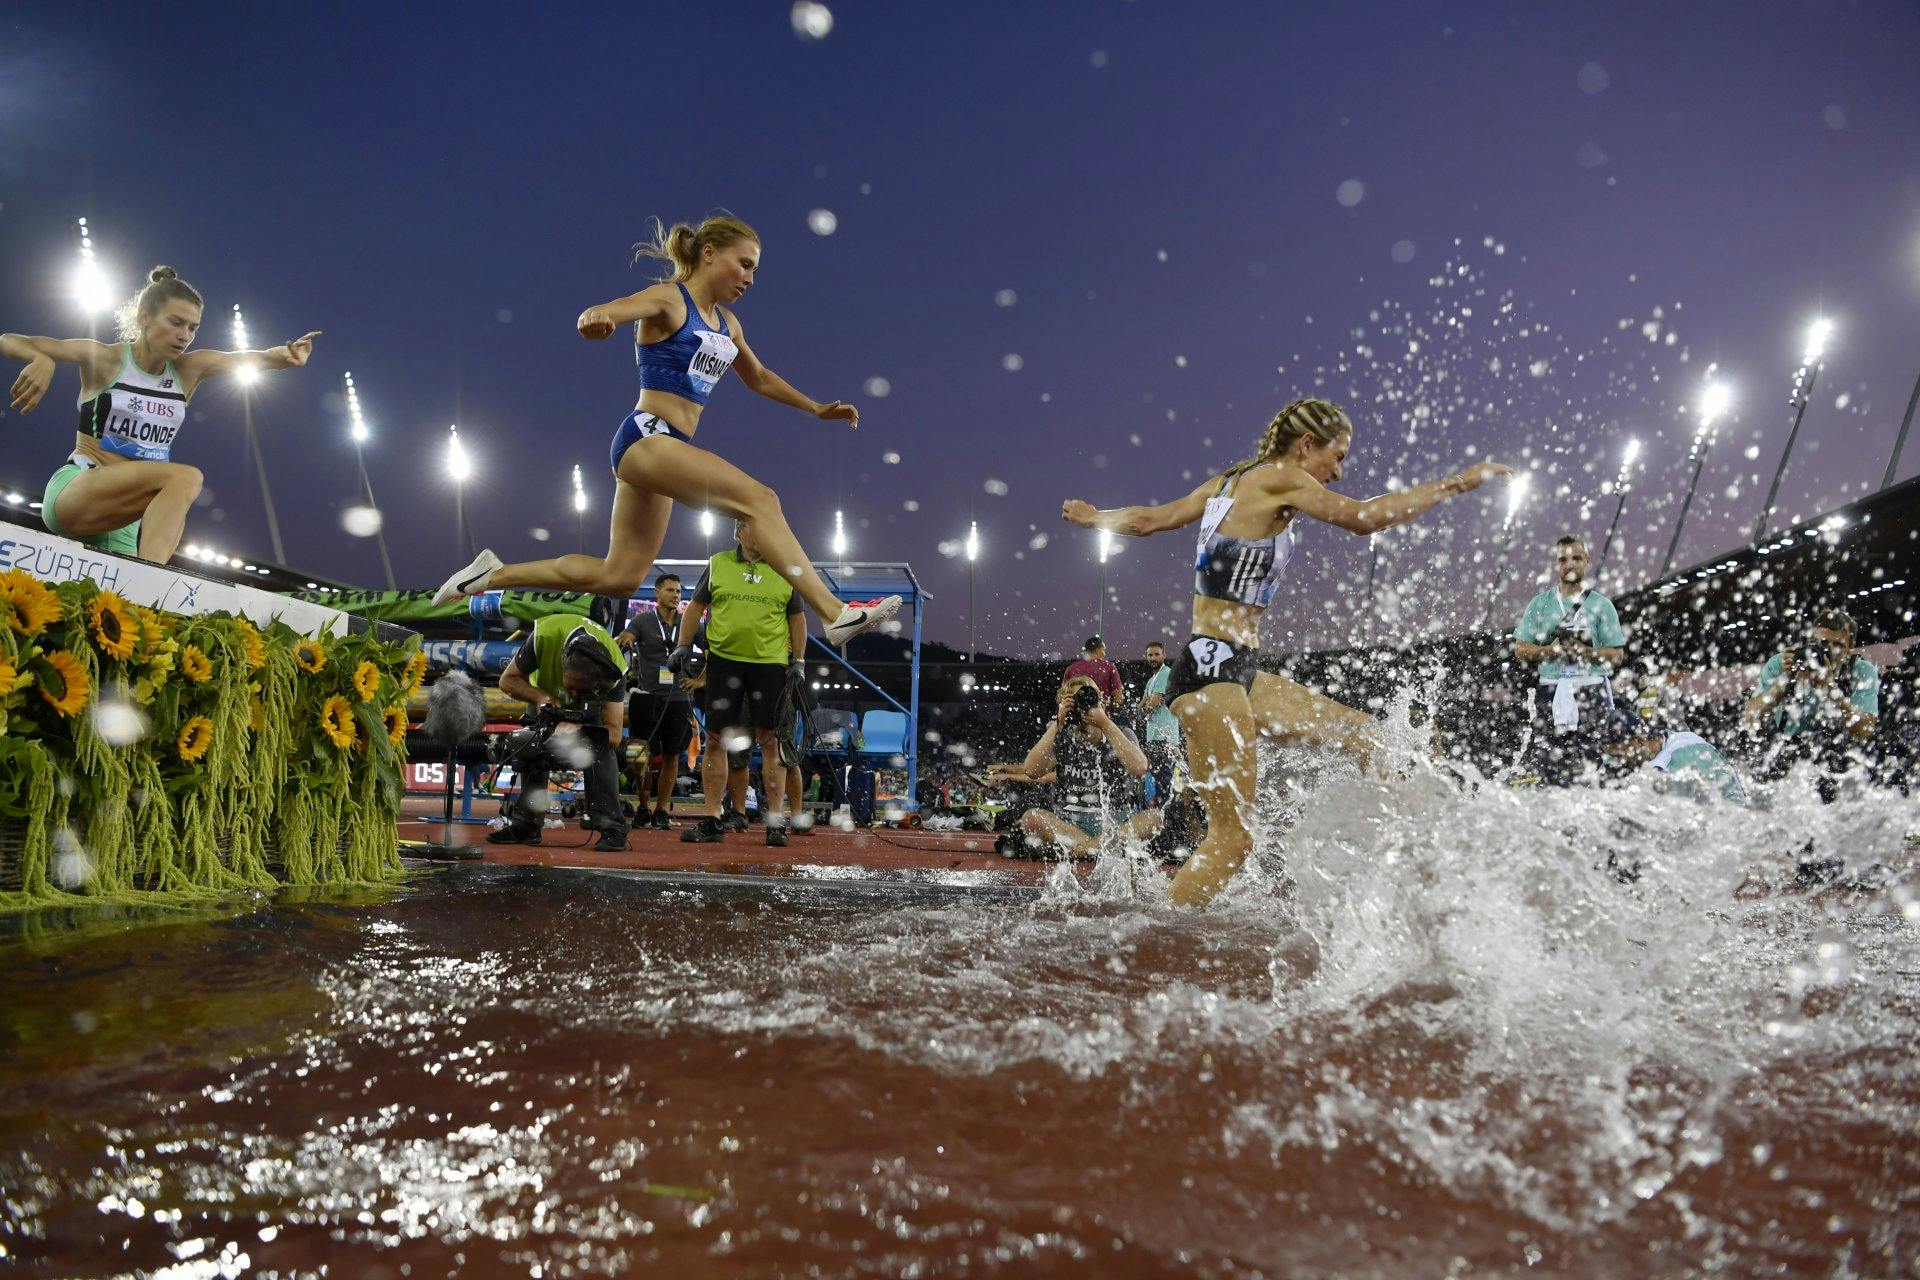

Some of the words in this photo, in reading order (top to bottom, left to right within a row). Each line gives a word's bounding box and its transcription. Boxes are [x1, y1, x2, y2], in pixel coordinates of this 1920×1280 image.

[146, 401, 175, 418] UBS
[108, 415, 175, 444] LALONDE
[643, 416, 660, 434] 4
[1200, 640, 1218, 666] 3
[1063, 764, 1109, 780] PHOT
